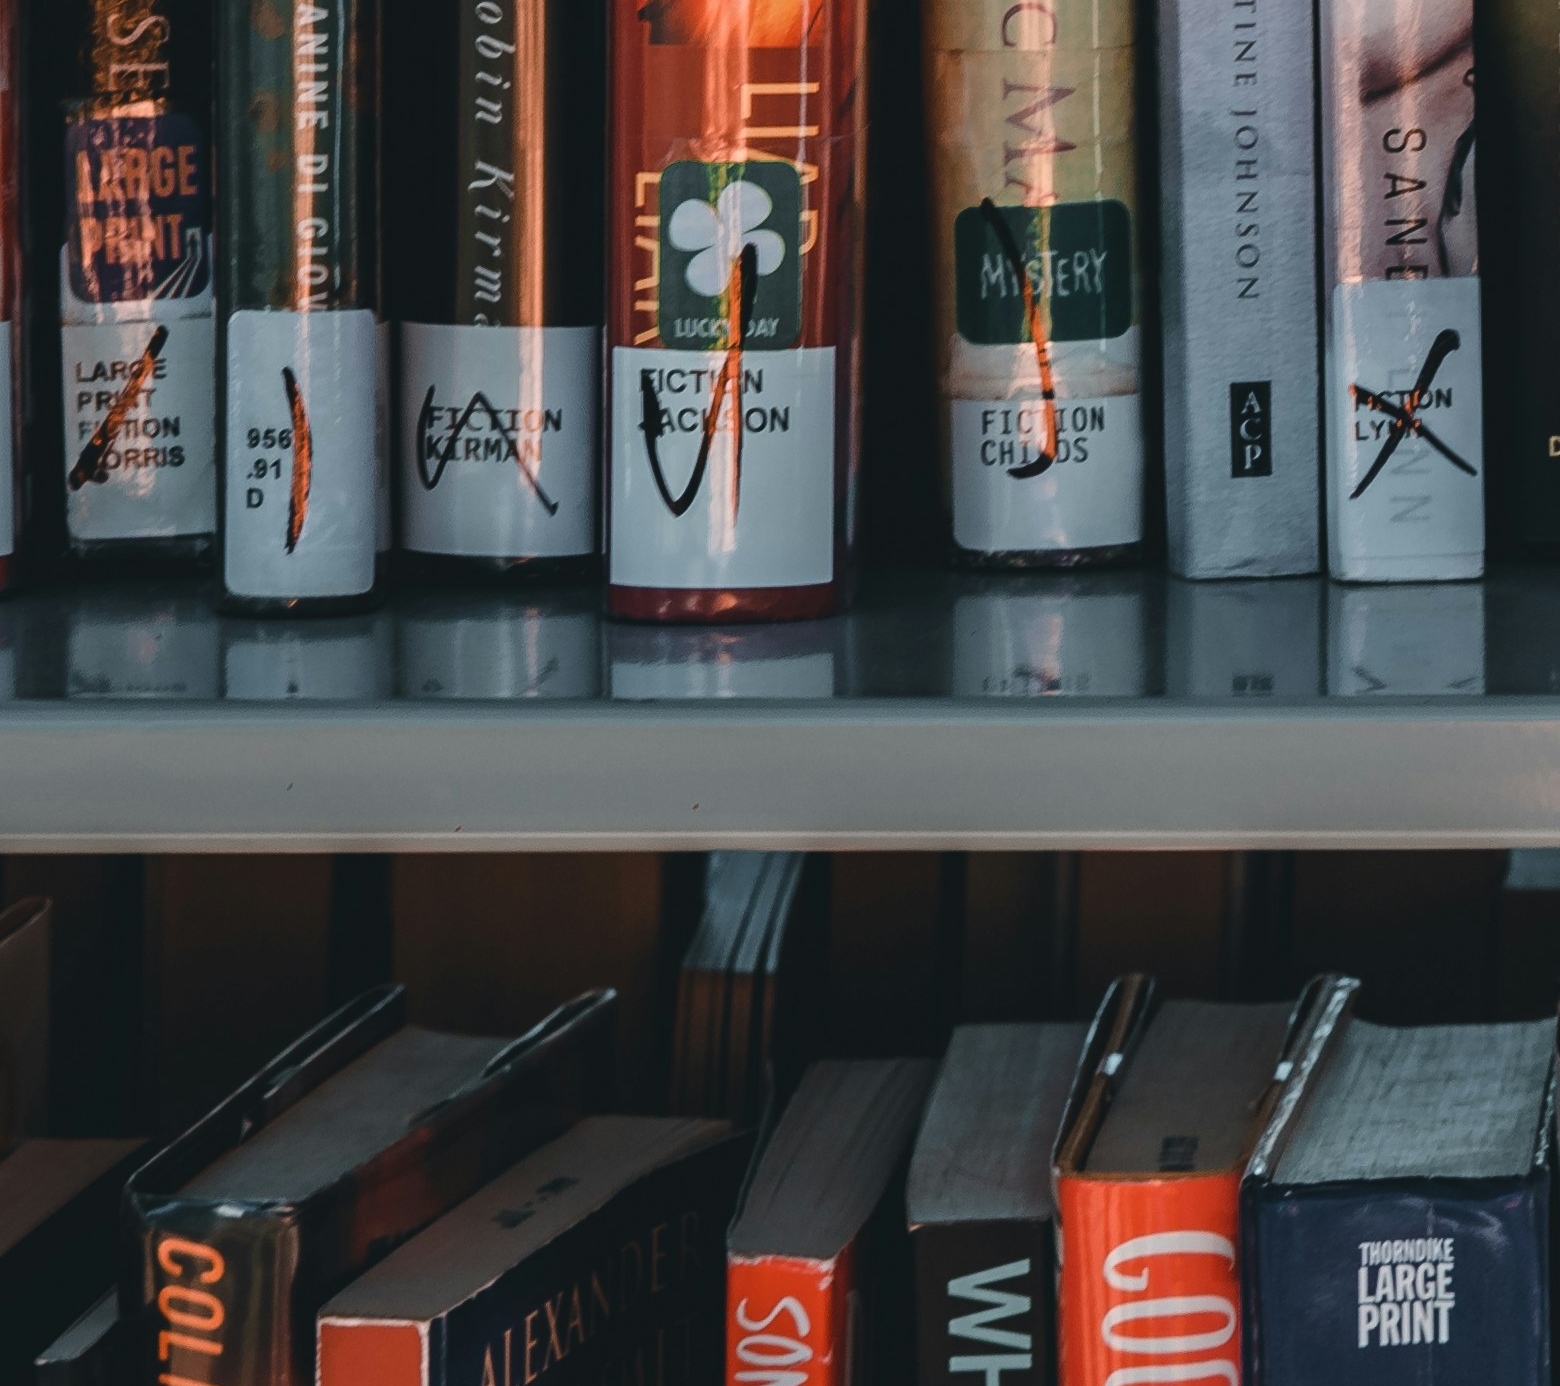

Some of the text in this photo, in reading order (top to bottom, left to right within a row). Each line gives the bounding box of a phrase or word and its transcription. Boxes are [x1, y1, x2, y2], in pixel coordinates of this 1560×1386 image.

[1358, 1238, 1456, 1265] THORNDIKE
[1356, 1266, 1454, 1304] LARGE
[1356, 1303, 1452, 1346] PRINT
